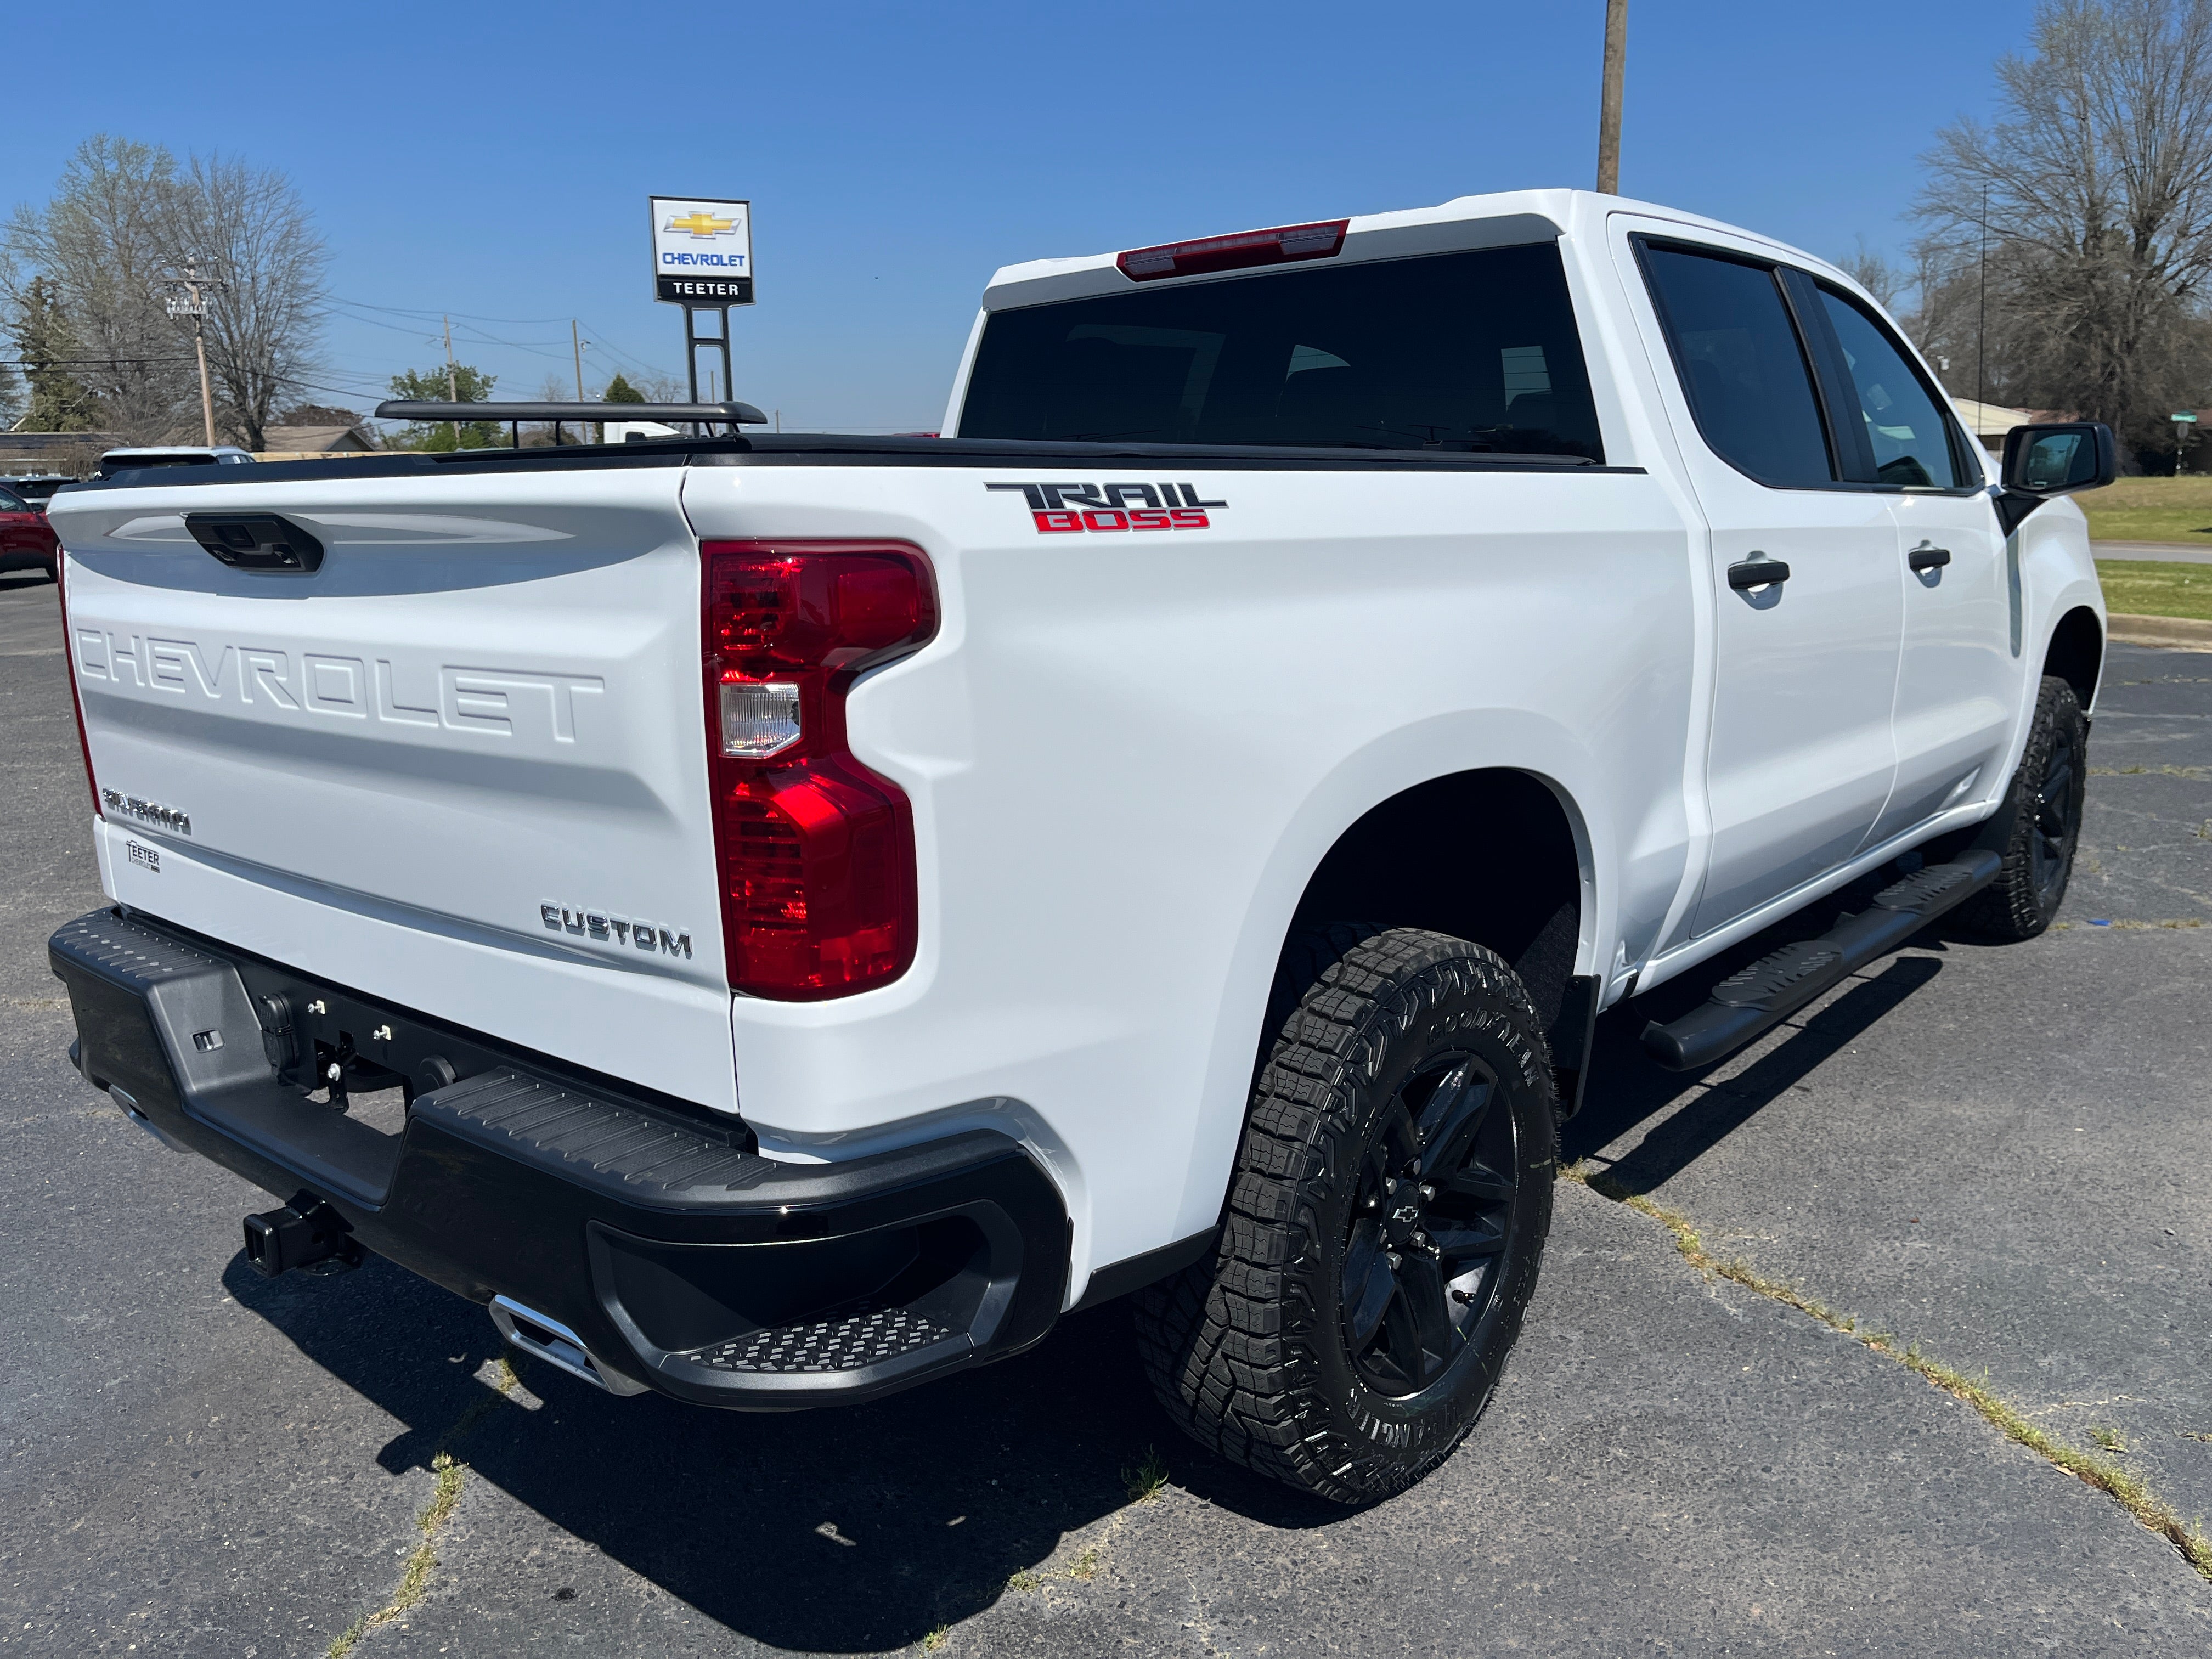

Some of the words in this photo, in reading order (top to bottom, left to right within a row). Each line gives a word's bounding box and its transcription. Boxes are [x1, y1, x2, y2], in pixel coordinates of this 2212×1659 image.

[663, 252, 744, 267] CHEVROLET
[673, 282, 738, 296] TEETER
[983, 482, 1229, 510] TRAIL
[1031, 509, 1210, 534] BOSS
[77, 628, 605, 743] CHEVROLET
[126, 840, 160, 866] TEETER
[541, 904, 692, 953] CUSTOM
[1427, 1007, 1539, 1088] GOODYEAR
